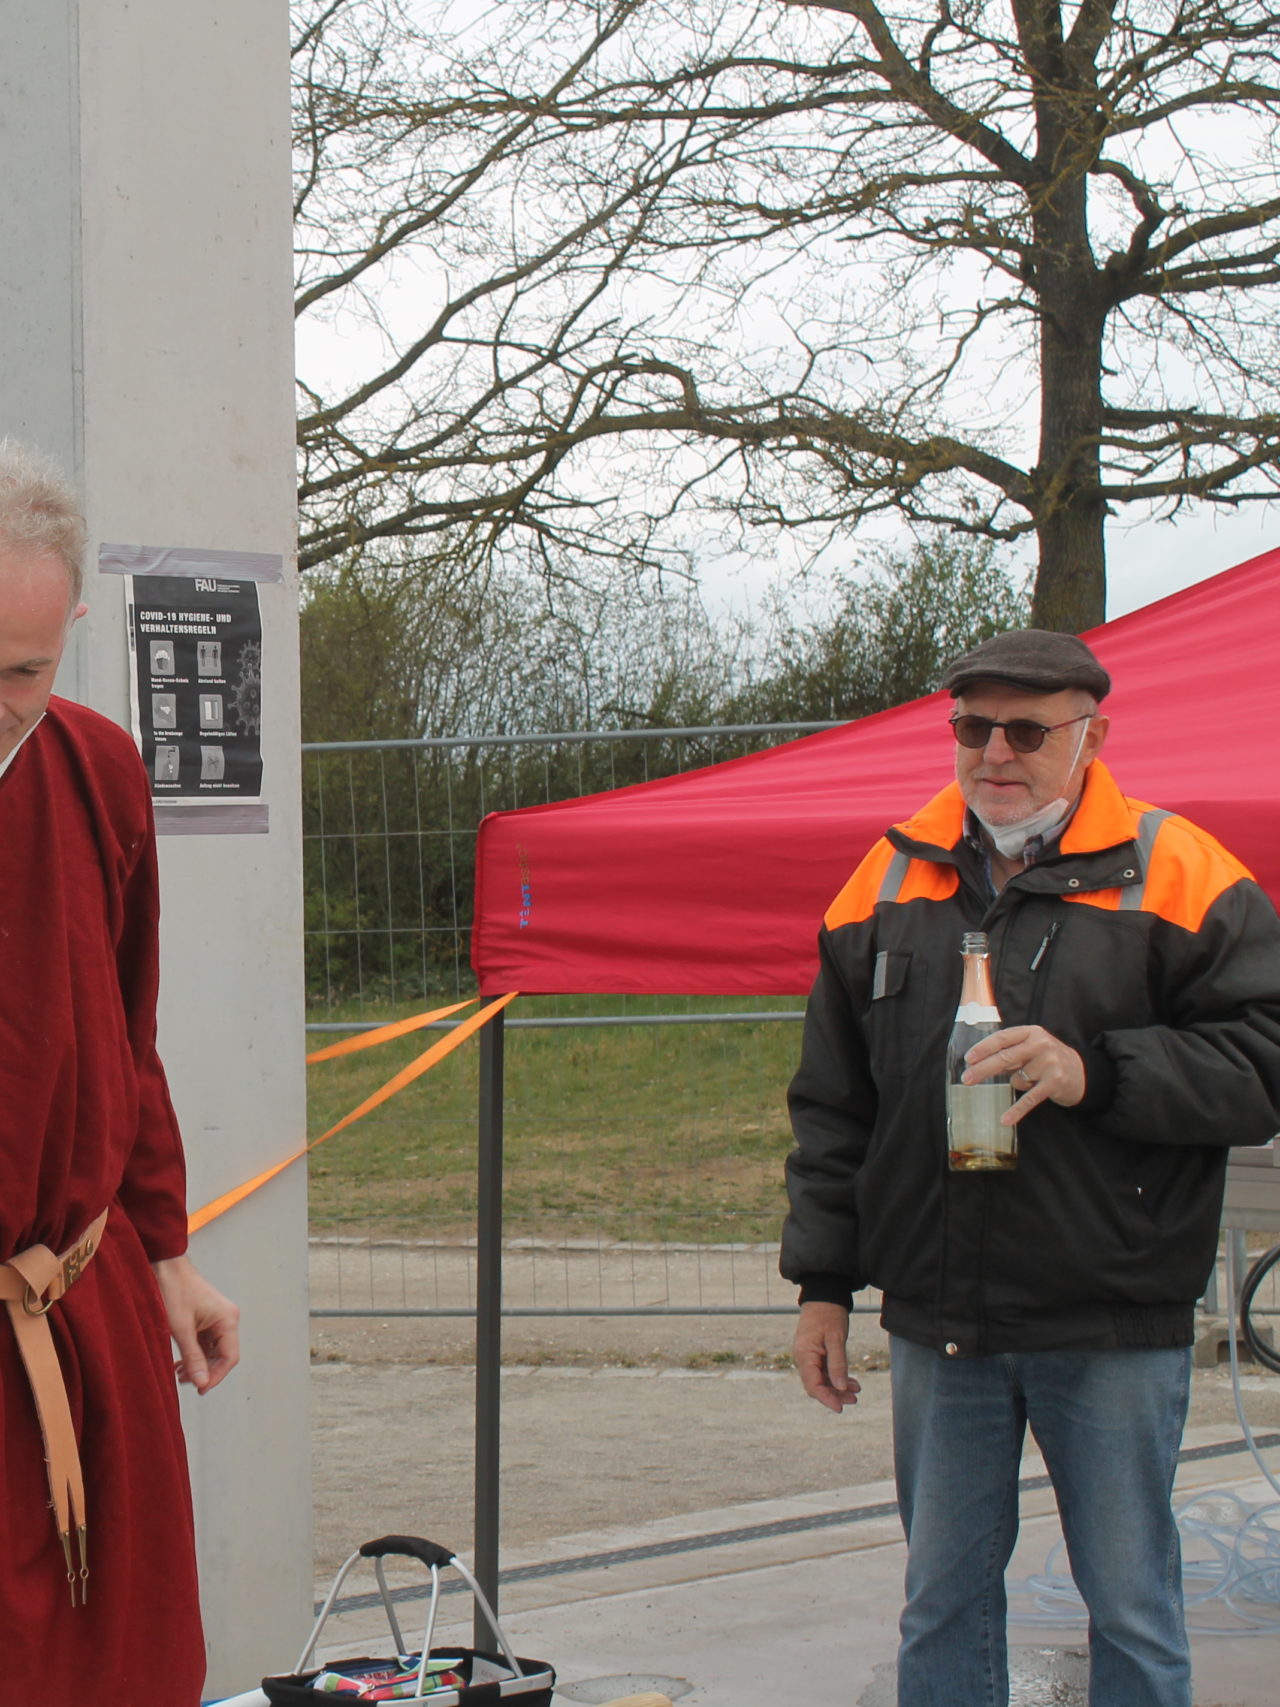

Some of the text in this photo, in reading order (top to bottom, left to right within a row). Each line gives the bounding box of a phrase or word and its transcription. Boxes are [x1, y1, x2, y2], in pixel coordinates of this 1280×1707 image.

[195, 578, 217, 592] FAU
[140, 611, 232, 623] COVID-19 HYGIENE- UND
[140, 623, 217, 634] VERHALTENSREGELN
